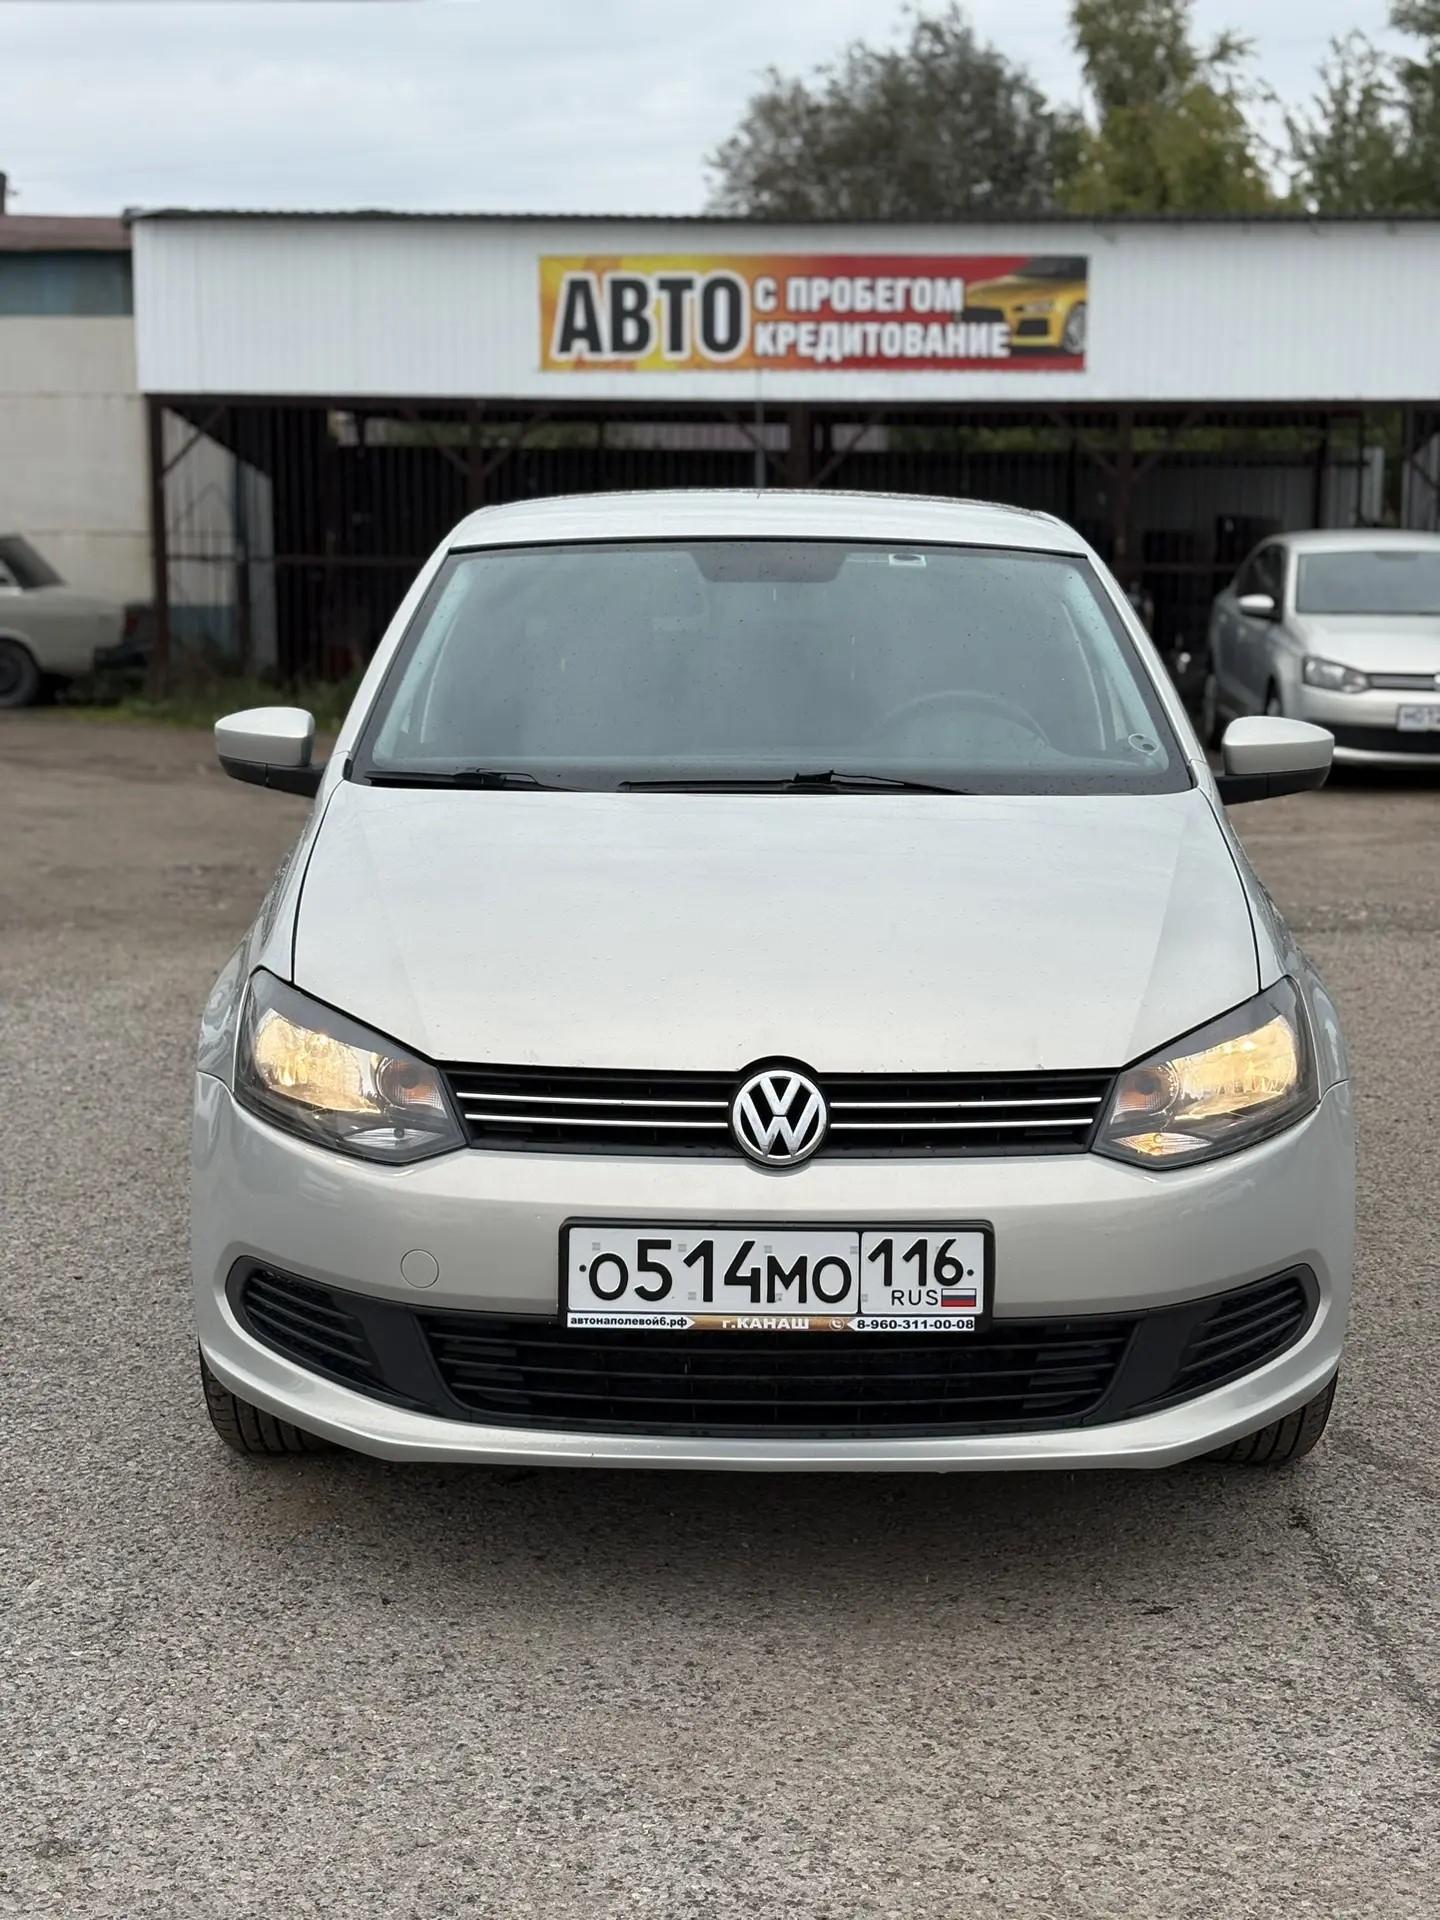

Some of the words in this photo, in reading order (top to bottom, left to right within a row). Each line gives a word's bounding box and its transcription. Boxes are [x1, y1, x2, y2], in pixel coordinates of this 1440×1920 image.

[754, 276, 777, 312] С
[786, 276, 964, 312] ПРОБЕГОМ
[555, 274, 744, 356] АВТО
[754, 321, 1011, 362] КРЕДИТОВАНИЕ
[890, 1289, 939, 1306] RUS
[570, 1315, 688, 1328] автонаполевой6.рф
[721, 1318, 809, 1330] г.КАНАШ
[856, 1318, 974, 1330] 8-960-311-00-08
